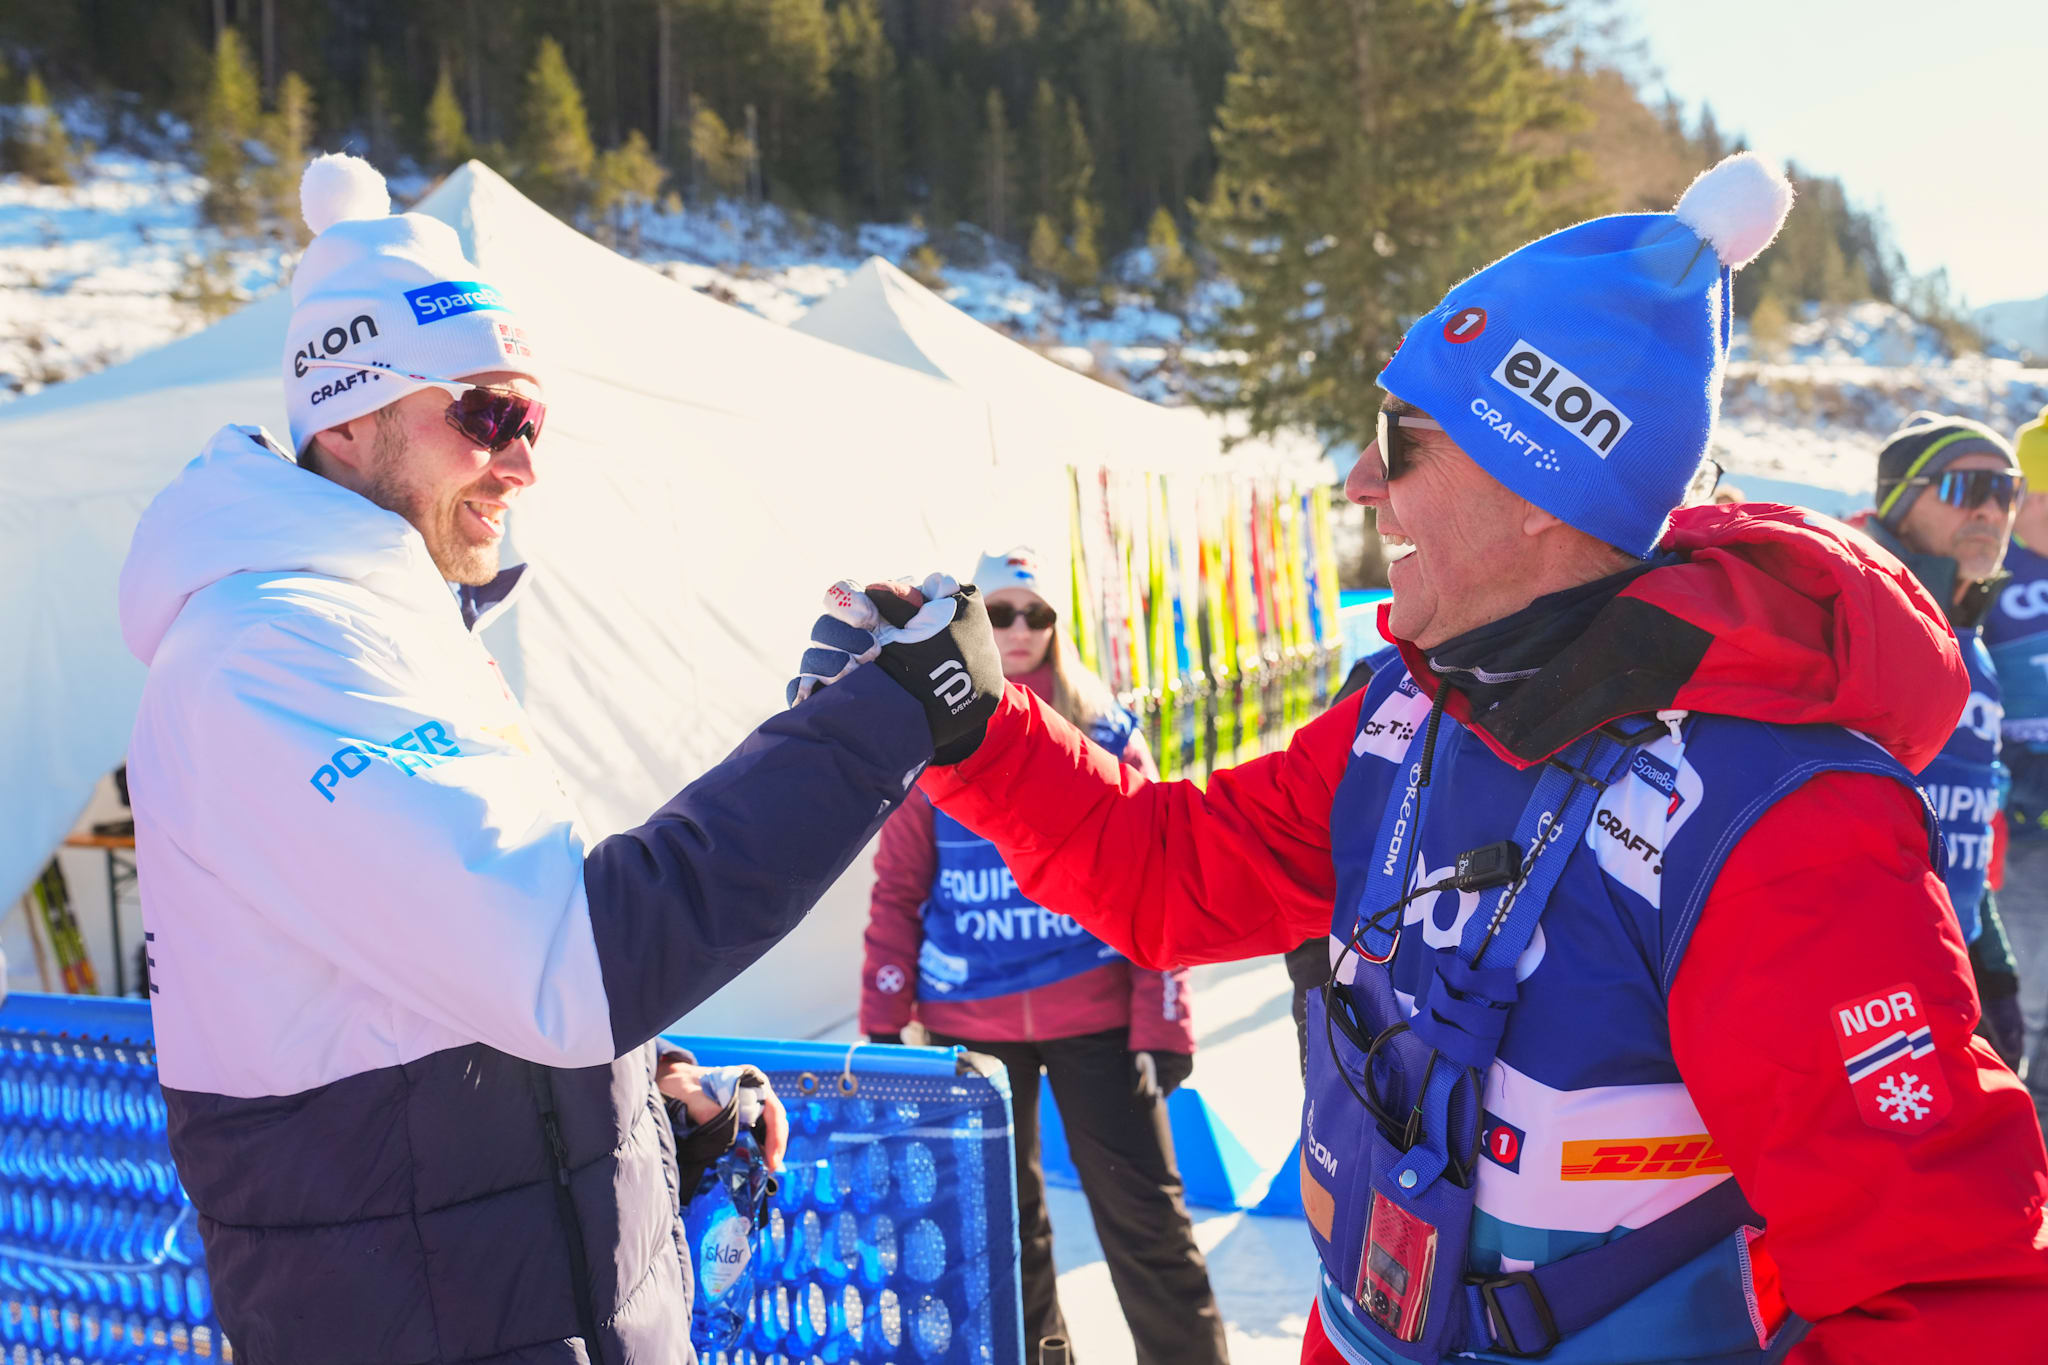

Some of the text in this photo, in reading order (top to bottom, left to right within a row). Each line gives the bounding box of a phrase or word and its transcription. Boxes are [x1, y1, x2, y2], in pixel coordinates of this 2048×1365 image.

[310, 369, 370, 405] CRAFT
[1470, 398, 1544, 457] CRAFT
[1596, 809, 1660, 863] CRAFT
[1839, 991, 1917, 1037] NOR
